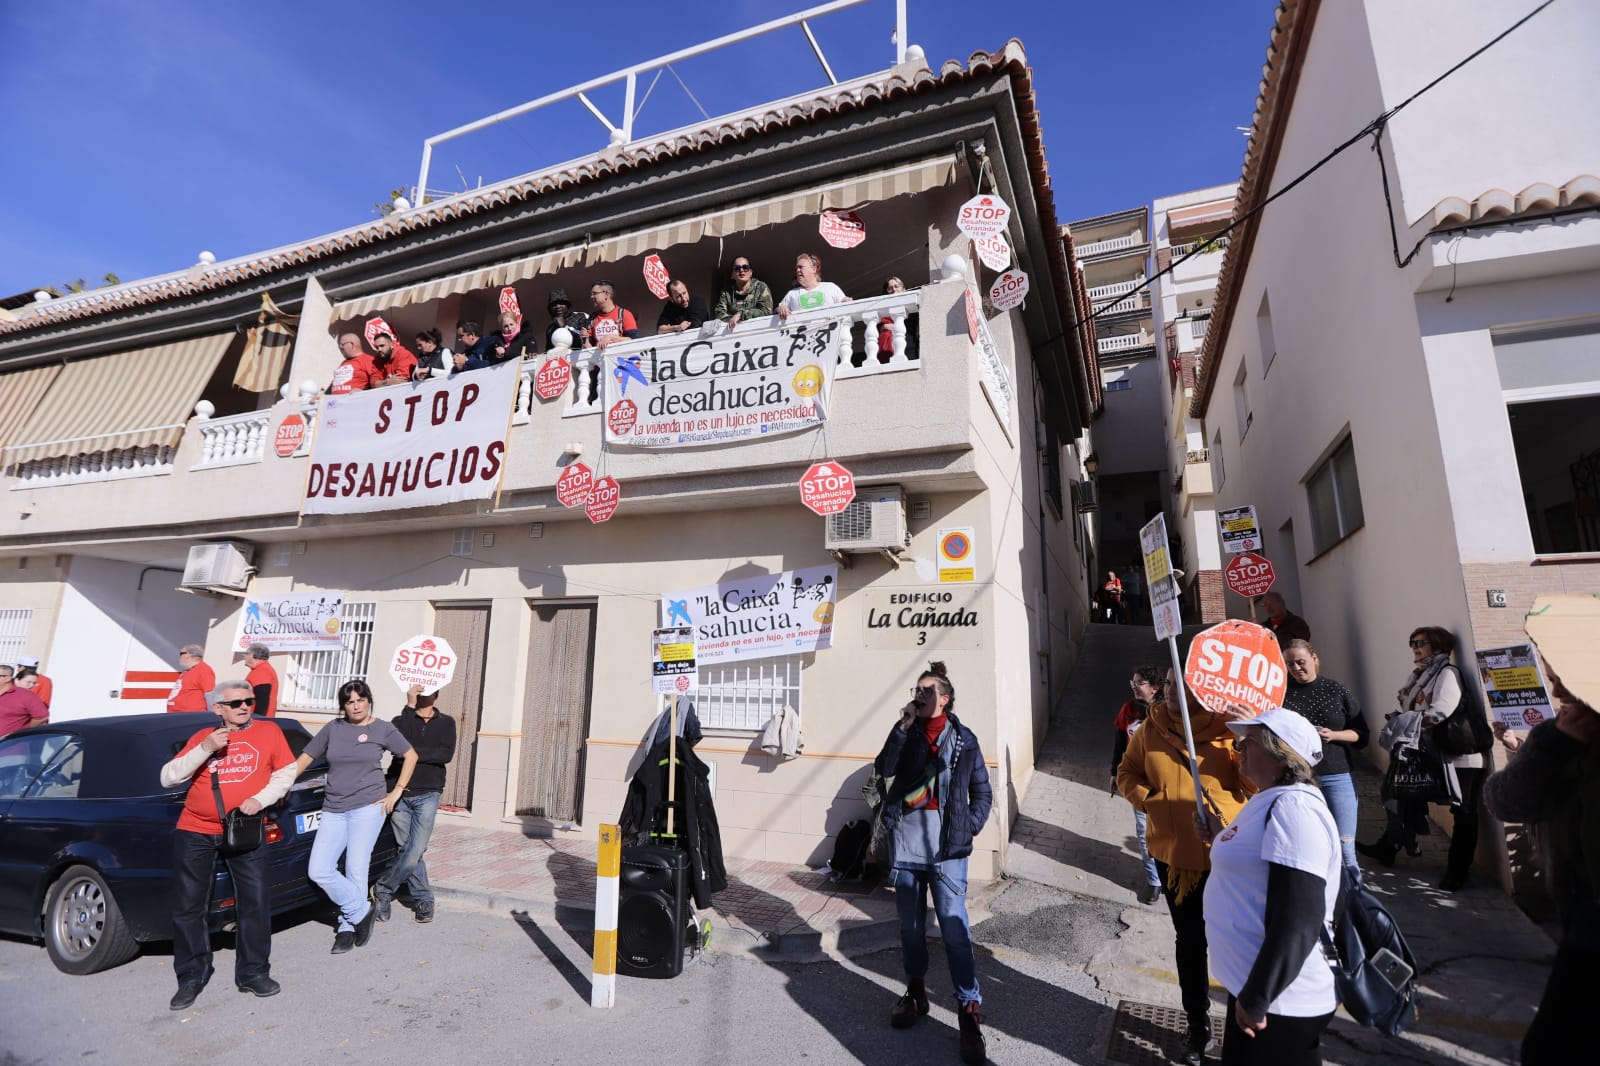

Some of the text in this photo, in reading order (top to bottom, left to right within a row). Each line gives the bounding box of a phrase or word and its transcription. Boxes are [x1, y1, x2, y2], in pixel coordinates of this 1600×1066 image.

[962, 207, 1006, 219] STOP
[823, 217, 862, 231] STOP
[978, 239, 1008, 254] STOP
[647, 260, 671, 287] STOP
[992, 276, 1024, 297] STOP
[596, 326, 617, 334] STOP
[538, 366, 569, 383] STOP
[542, 384, 564, 393] Granada
[649, 376, 790, 416] desahucia,
[612, 407, 636, 419] STOP
[634, 424, 644, 435] La
[646, 418, 681, 434] vivienda
[684, 420, 695, 432] no
[697, 419, 708, 431] es
[710, 417, 723, 429] un
[746, 413, 758, 425] es
[761, 402, 816, 423] necesidad
[278, 425, 303, 438] STOP
[307, 440, 505, 498] DESAHUCIOS
[559, 472, 591, 491] STOP
[803, 475, 849, 493] STOP
[559, 484, 591, 498] Desahucios
[564, 491, 587, 502] Granada
[588, 487, 617, 505] STOP
[805, 489, 852, 501] Desahucios
[812, 497, 847, 507] Granada
[591, 507, 613, 517] Granada
[1228, 562, 1269, 581] STOP
[1231, 574, 1272, 587] Desahucios
[1238, 582, 1269, 592] Granada
[890, 592, 953, 604] EDIFICIO
[1496, 594, 1504, 602] 6
[698, 608, 802, 640] sahucia,
[867, 606, 978, 628] La Cañada
[697, 641, 729, 651] vivienda
[766, 634, 784, 643] lujo,
[917, 631, 927, 646] 3
[397, 649, 451, 670] STOP
[394, 664, 447, 679] Desahucios
[1198, 638, 1284, 696] STOP
[399, 673, 438, 686] Granada
[1506, 690, 1536, 700] ¡los deja
[1527, 696, 1548, 704] calle!
[1524, 712, 1543, 720] STOP
[217, 766, 252, 775] ESAHUCIOS
